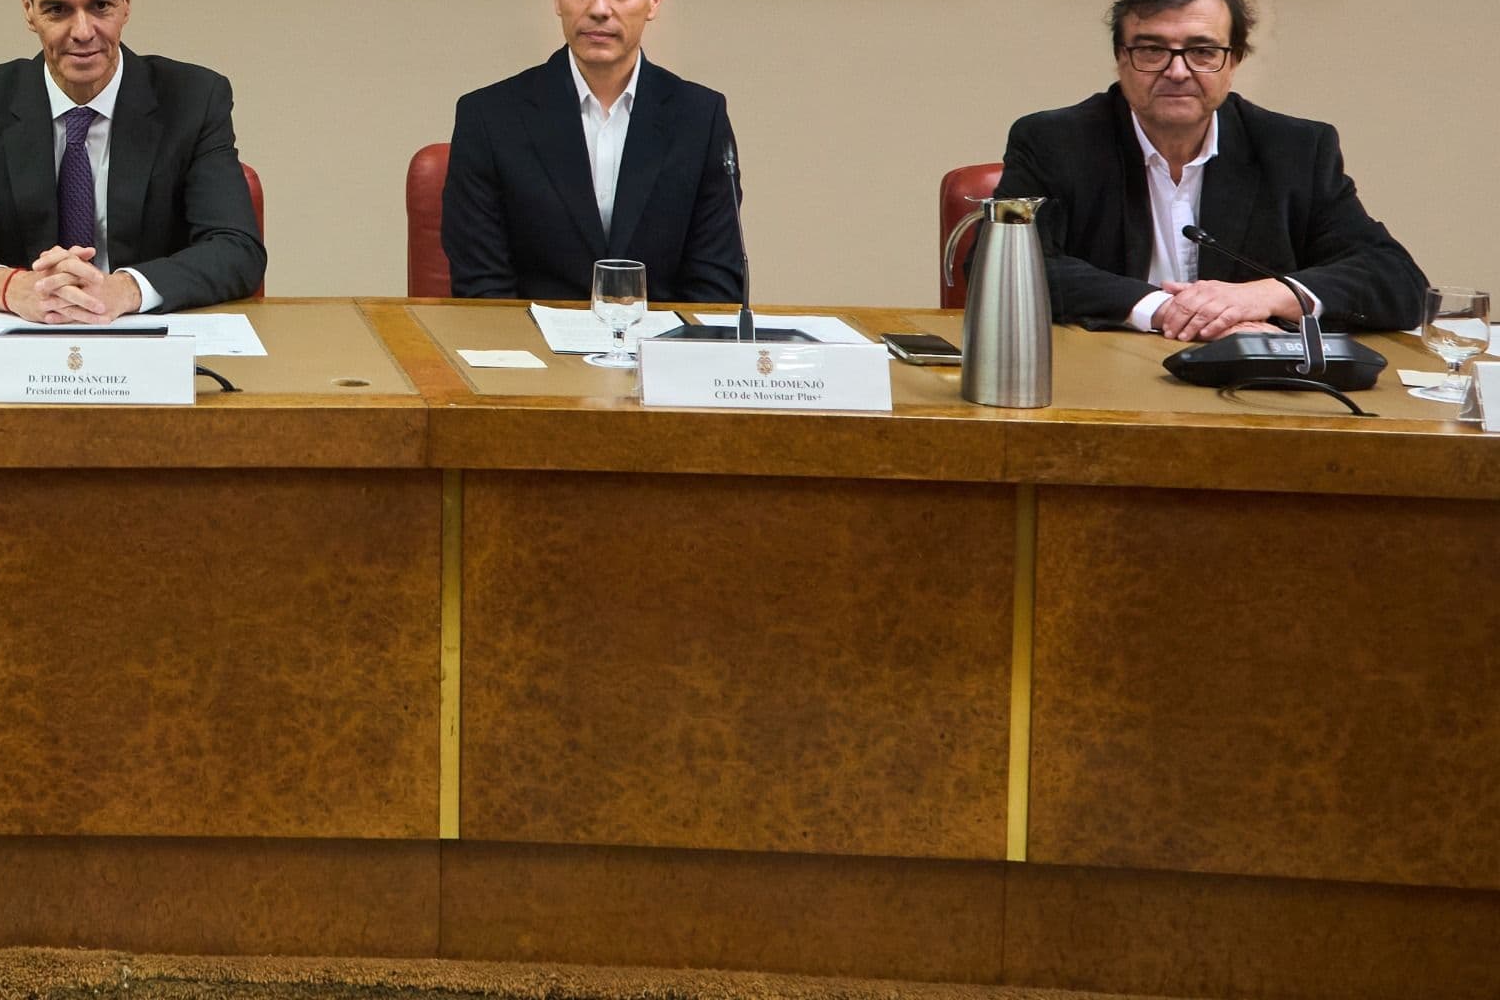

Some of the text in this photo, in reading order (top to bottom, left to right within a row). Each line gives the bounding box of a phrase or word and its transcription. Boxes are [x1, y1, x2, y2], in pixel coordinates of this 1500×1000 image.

[1285, 342, 1332, 351] BOH
[28, 373, 128, 384] D. PEDRO SÁNCHEZ
[714, 379, 724, 388] D.
[727, 379, 768, 387] DANIEL
[26, 387, 130, 396] Presidente del Gobierno
[715, 391, 823, 401] CEO de Movistar Plus+
